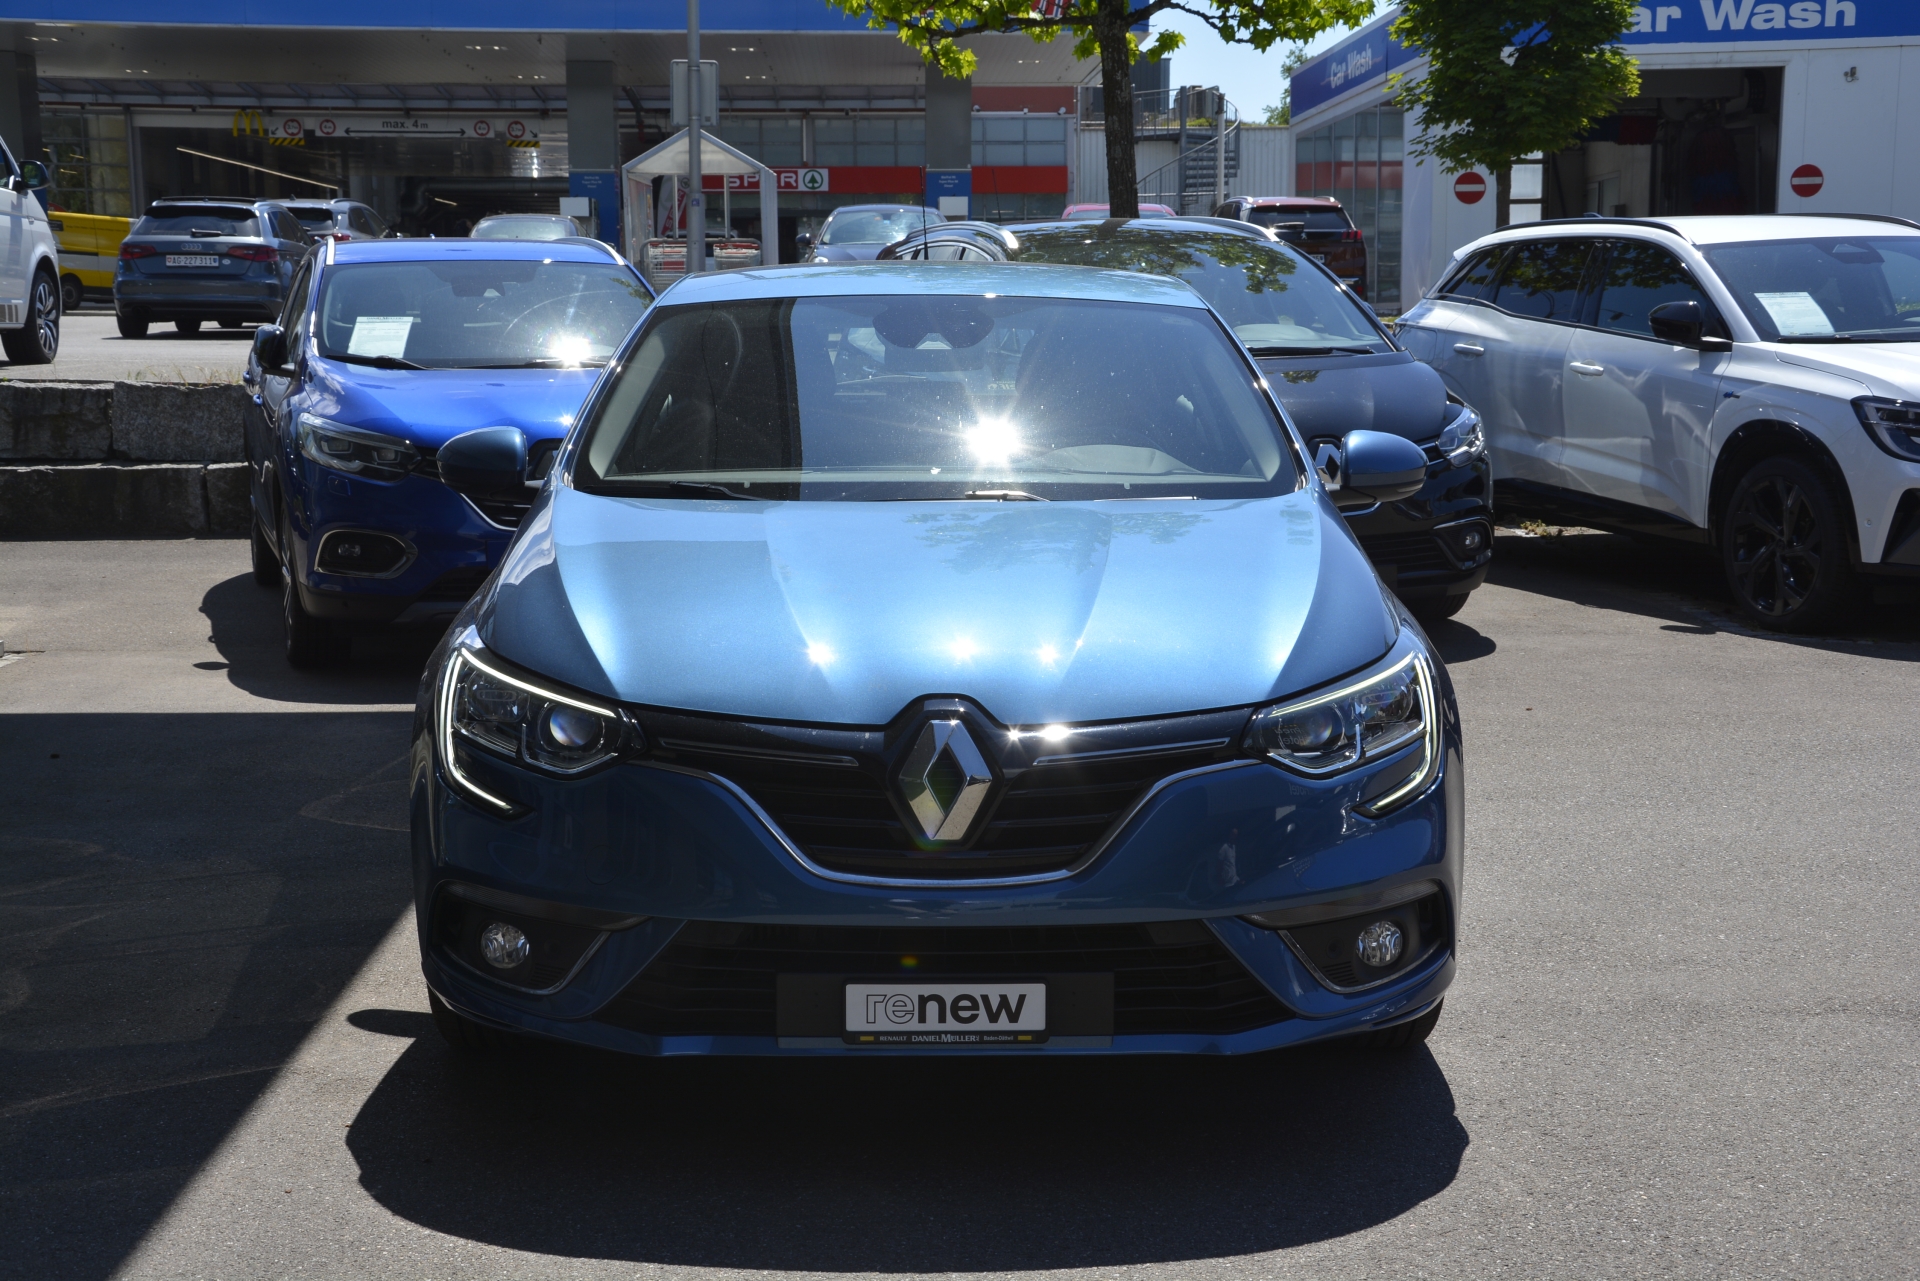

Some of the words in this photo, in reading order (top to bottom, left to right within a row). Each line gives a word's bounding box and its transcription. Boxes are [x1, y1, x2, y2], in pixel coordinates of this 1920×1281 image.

[1621, 6, 1682, 33] ar
[1698, 0, 1857, 31] Wash
[1330, 61, 1347, 89] Car
[1347, 43, 1372, 80] Wash
[382, 120, 409, 129] max.
[729, 173, 797, 187] SPR
[866, 993, 1027, 1024] renew
